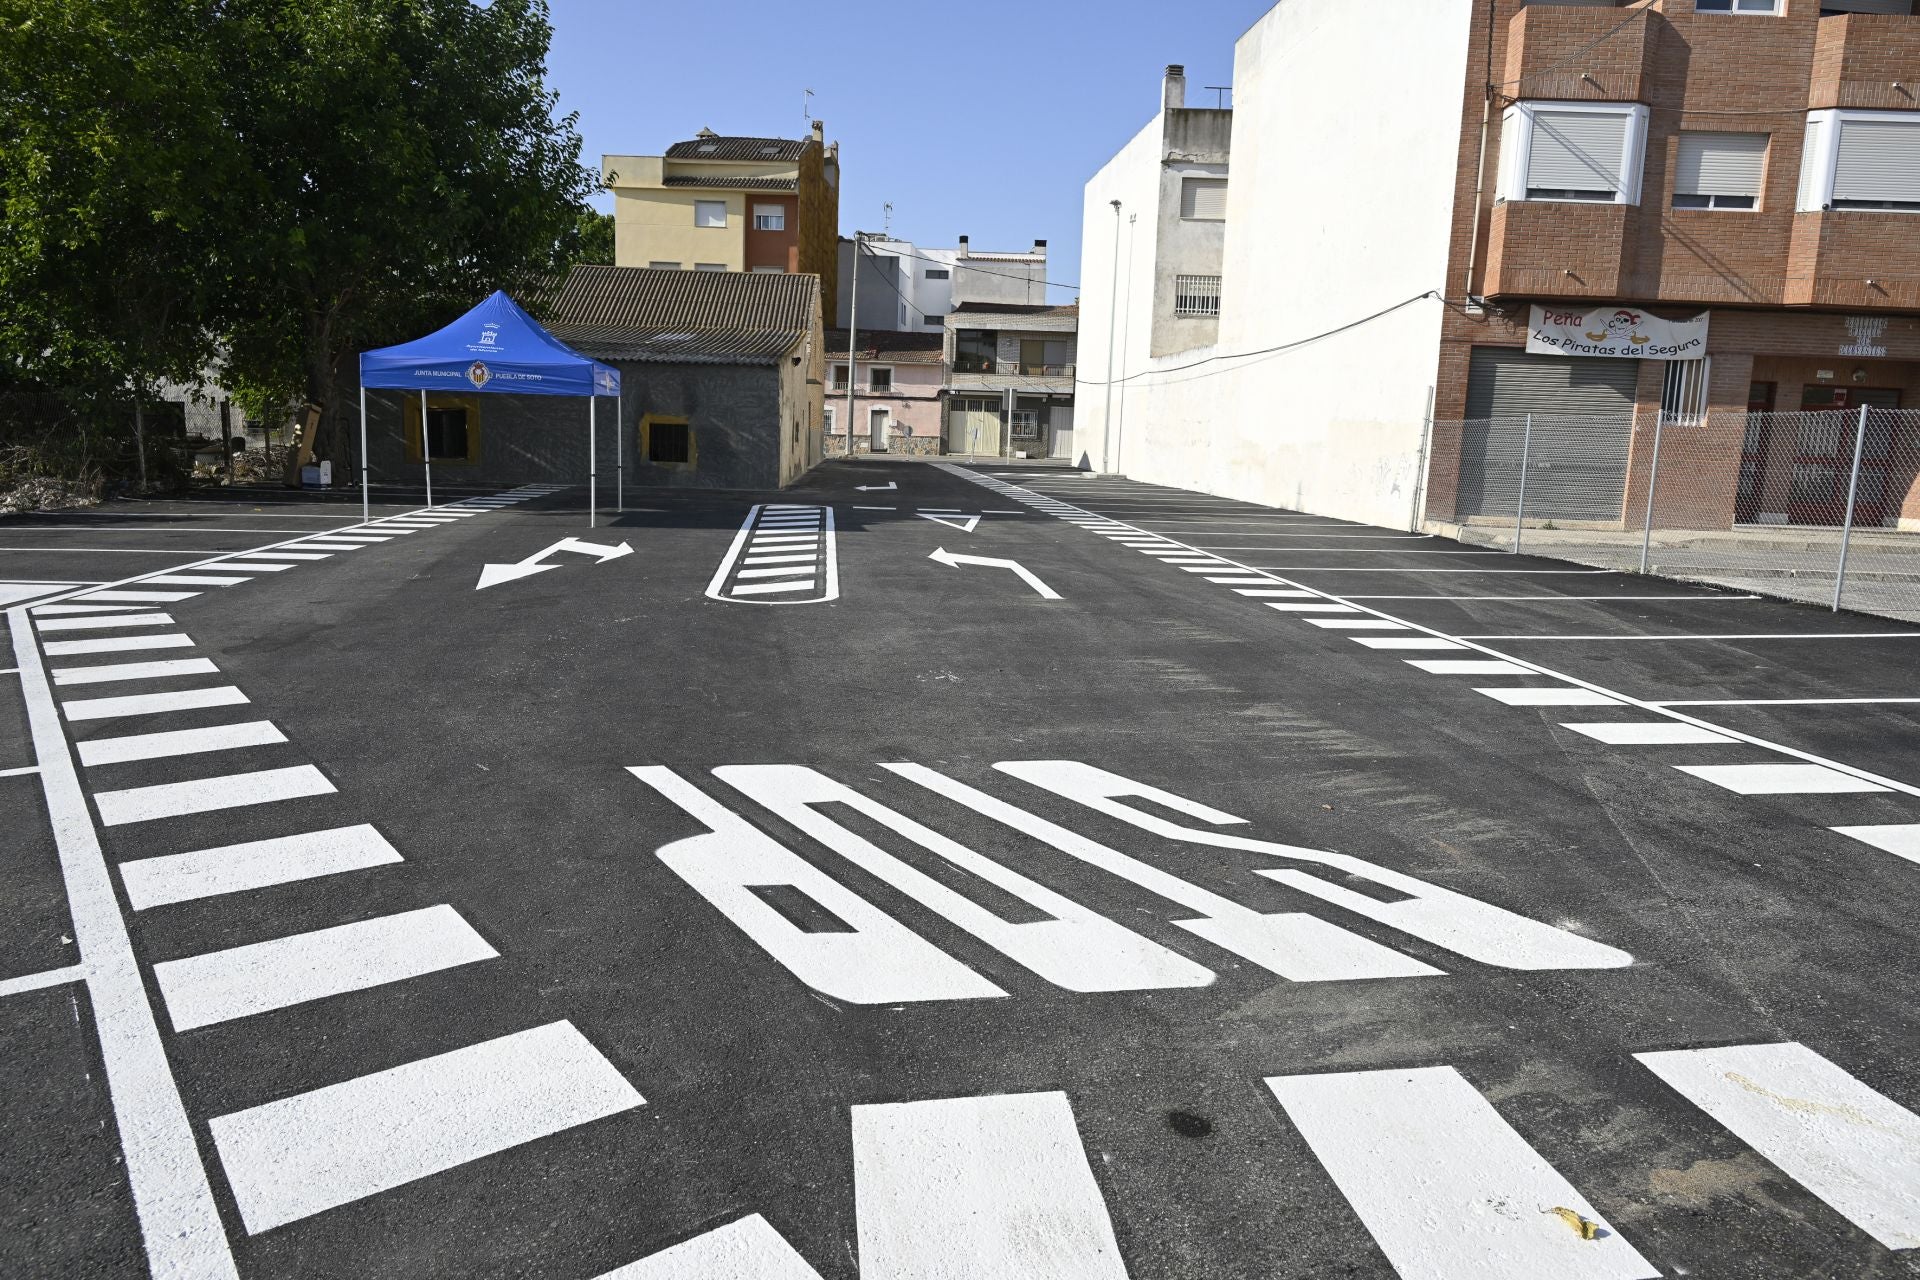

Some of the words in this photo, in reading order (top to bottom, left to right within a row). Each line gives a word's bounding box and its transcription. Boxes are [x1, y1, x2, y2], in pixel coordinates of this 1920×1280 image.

[1543, 311, 1583, 327] Peña
[1533, 329, 1559, 346] Los
[1561, 338, 1616, 356] Piratas
[1621, 344, 1644, 356] del
[1649, 338, 1701, 356] Segura
[626, 759, 1635, 1005] STOP
